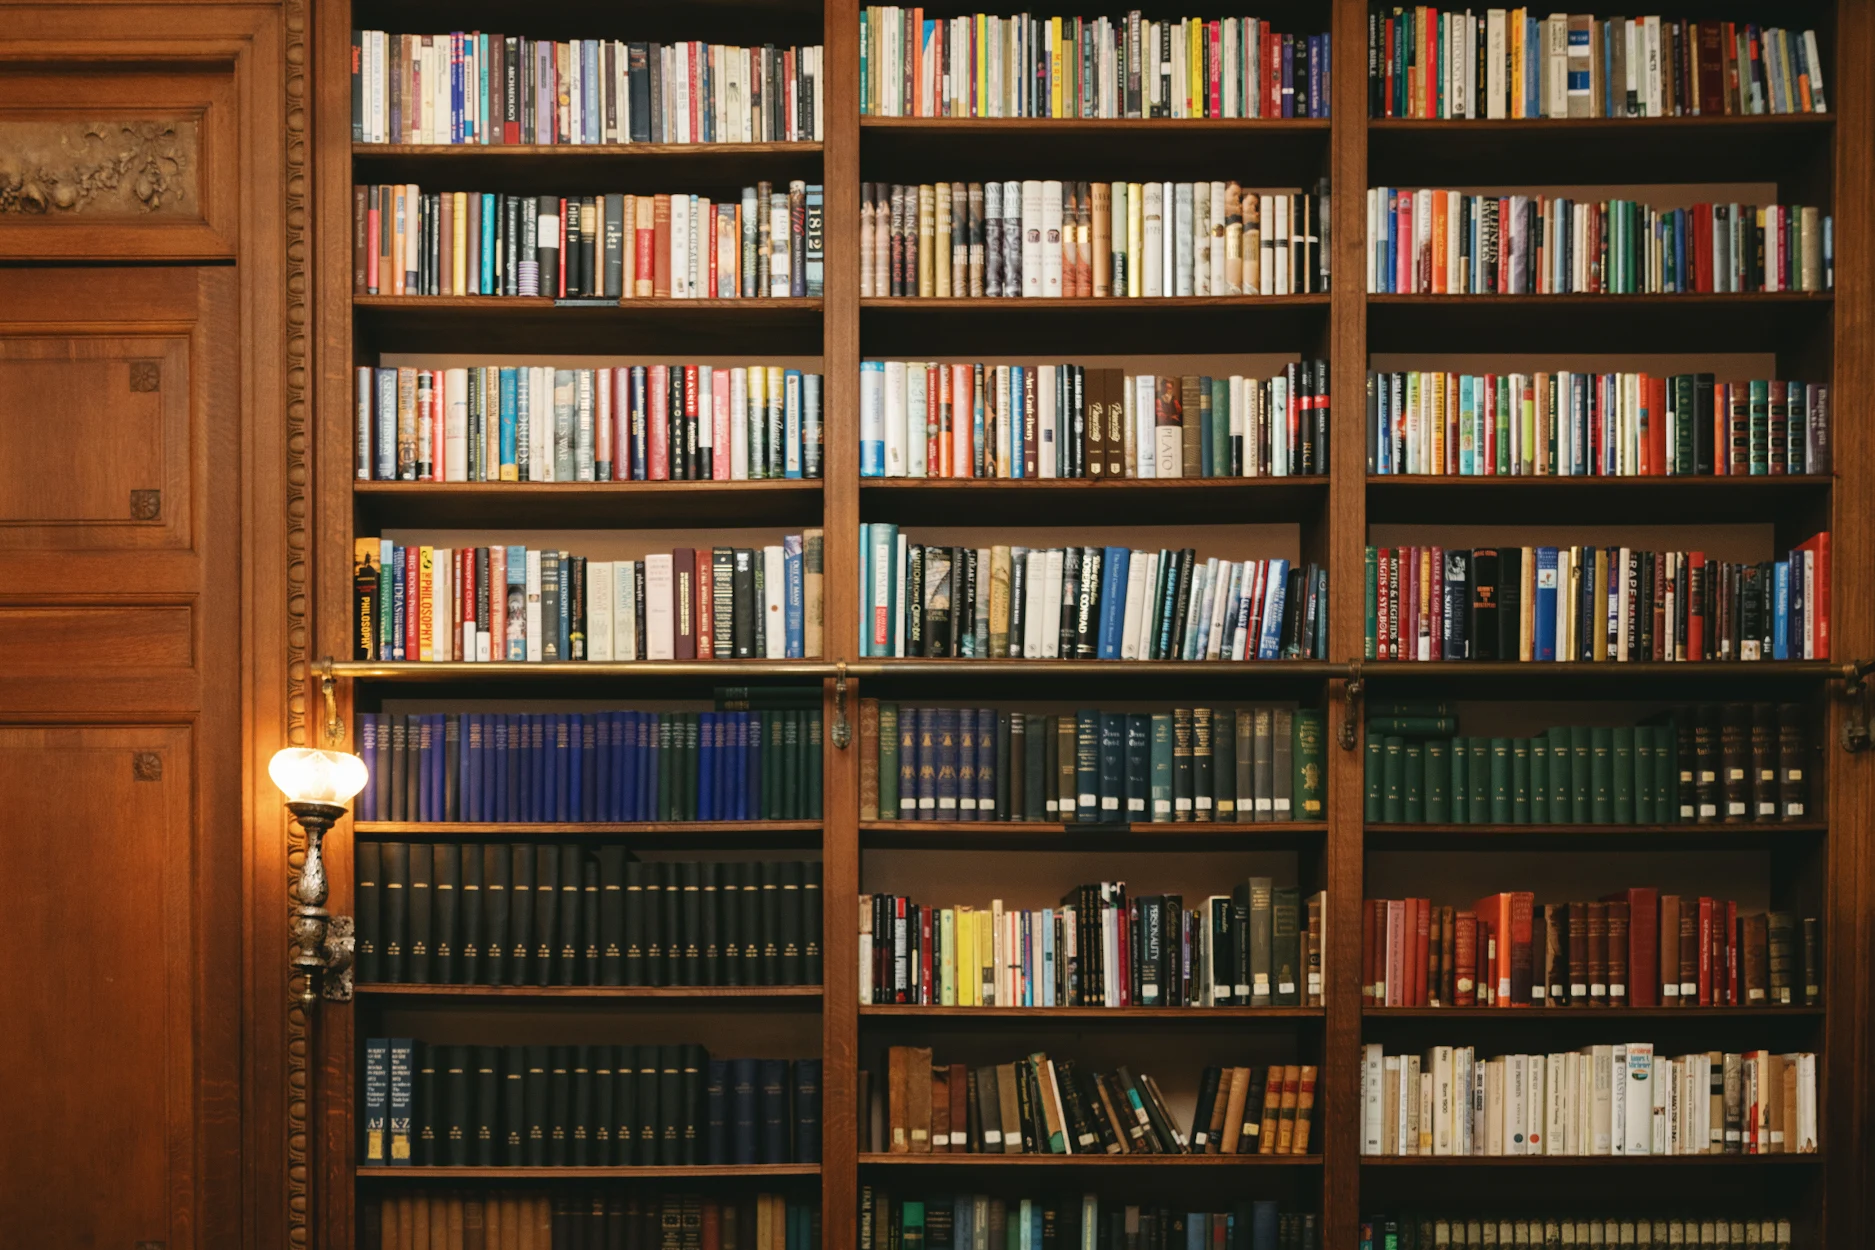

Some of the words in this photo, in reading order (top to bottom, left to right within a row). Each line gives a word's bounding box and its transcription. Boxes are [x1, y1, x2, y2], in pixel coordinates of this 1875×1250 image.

[1453, 17, 1462, 82] MYTHOLOGY
[792, 207, 805, 236] 1776
[808, 208, 822, 250] 1812
[894, 235, 902, 260] ANNE
[905, 235, 915, 260] ANNE
[894, 263, 902, 283] RICE
[906, 263, 914, 283] RICE
[383, 381, 391, 406] SENSE
[518, 381, 528, 406] THE
[383, 421, 391, 457] HISTORY
[518, 412, 528, 465] DRUIDS
[673, 380, 682, 466] CLEOPATRA
[750, 398, 764, 449] Mayflower
[770, 393, 783, 451] Mayflower
[558, 437, 568, 461] WAR
[1160, 428, 1173, 471] PLATO
[1303, 442, 1312, 468] RICE
[465, 552, 473, 590] Philosophical
[755, 571, 764, 589] 2012
[878, 547, 887, 605] CHAPMAN
[1080, 555, 1091, 592] JOSEPH
[1168, 567, 1177, 594] ESCAPE
[1380, 557, 1388, 586] SIGNS
[1390, 558, 1398, 589] MYTHS
[1629, 560, 1637, 597] RAPE
[382, 567, 390, 613] PHILOSOPHY
[394, 582, 404, 613] IDEAS
[1164, 596, 1173, 618] FROM
[1444, 595, 1452, 618] SCOTT
[1608, 594, 1618, 618] THRILL
[361, 597, 371, 649] PHILOSOPHY
[421, 579, 432, 642] PHILOSOPHY
[1078, 594, 1089, 634] CONRAD
[1162, 618, 1171, 631] THE
[1378, 596, 1388, 641] SYMBOLS
[1390, 599, 1398, 640] LEGENDS
[1453, 586, 1464, 645] LINDBERGH
[1608, 619, 1618, 634] KILL
[1628, 603, 1636, 649] NANKING
[1444, 619, 1452, 641] BERG
[1150, 904, 1158, 961] PERSONALITY
[1616, 1066, 1625, 1101] COASTS
[861, 1211, 871, 1248] PROBLEM
